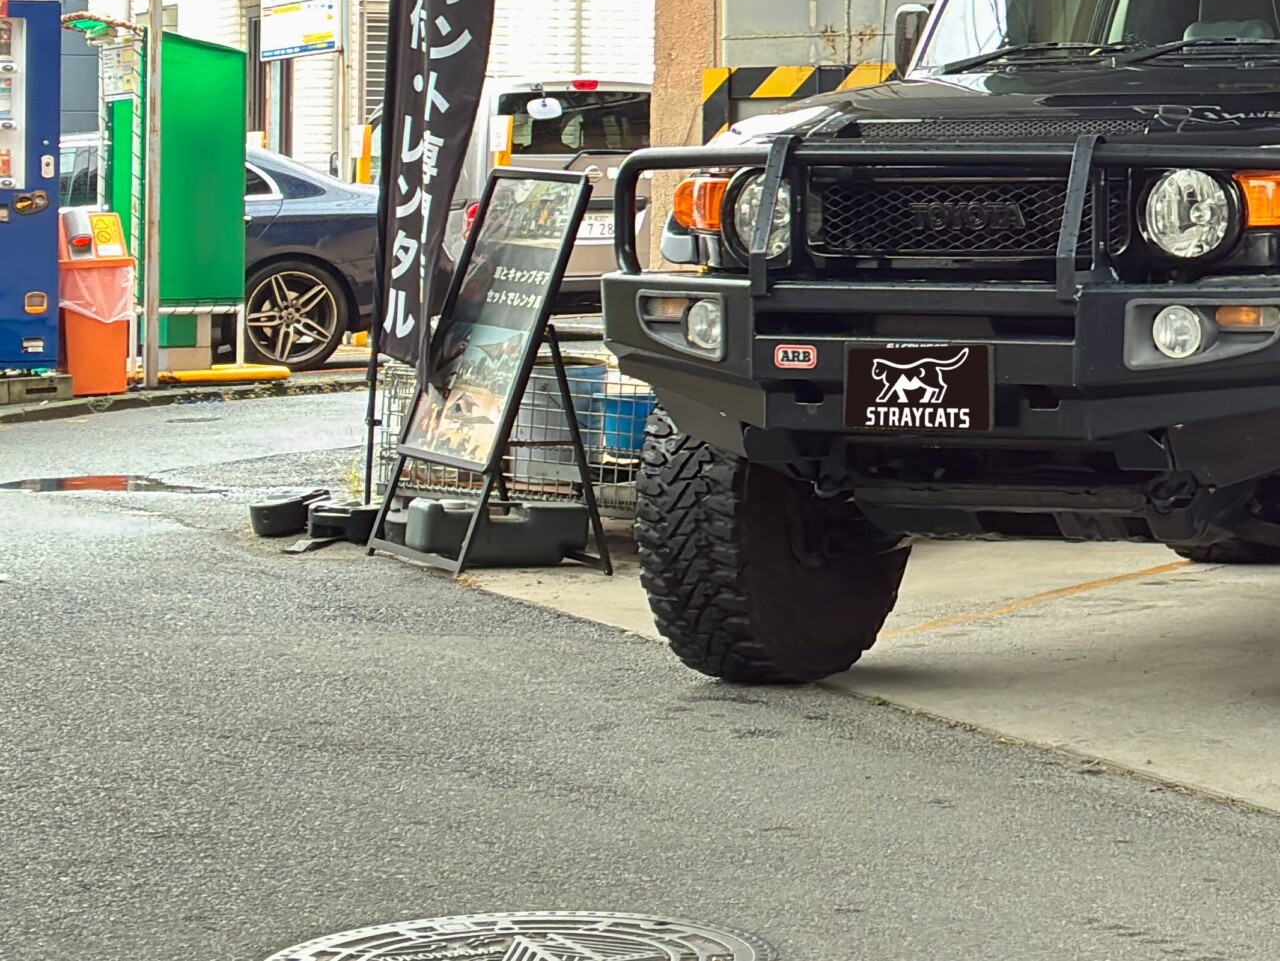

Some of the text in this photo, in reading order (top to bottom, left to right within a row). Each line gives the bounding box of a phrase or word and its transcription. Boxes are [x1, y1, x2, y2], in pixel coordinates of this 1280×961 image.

[908, 202, 1027, 230] TOYOTA
[780, 351, 812, 363] ARB
[865, 406, 970, 428] STRAYCATS
